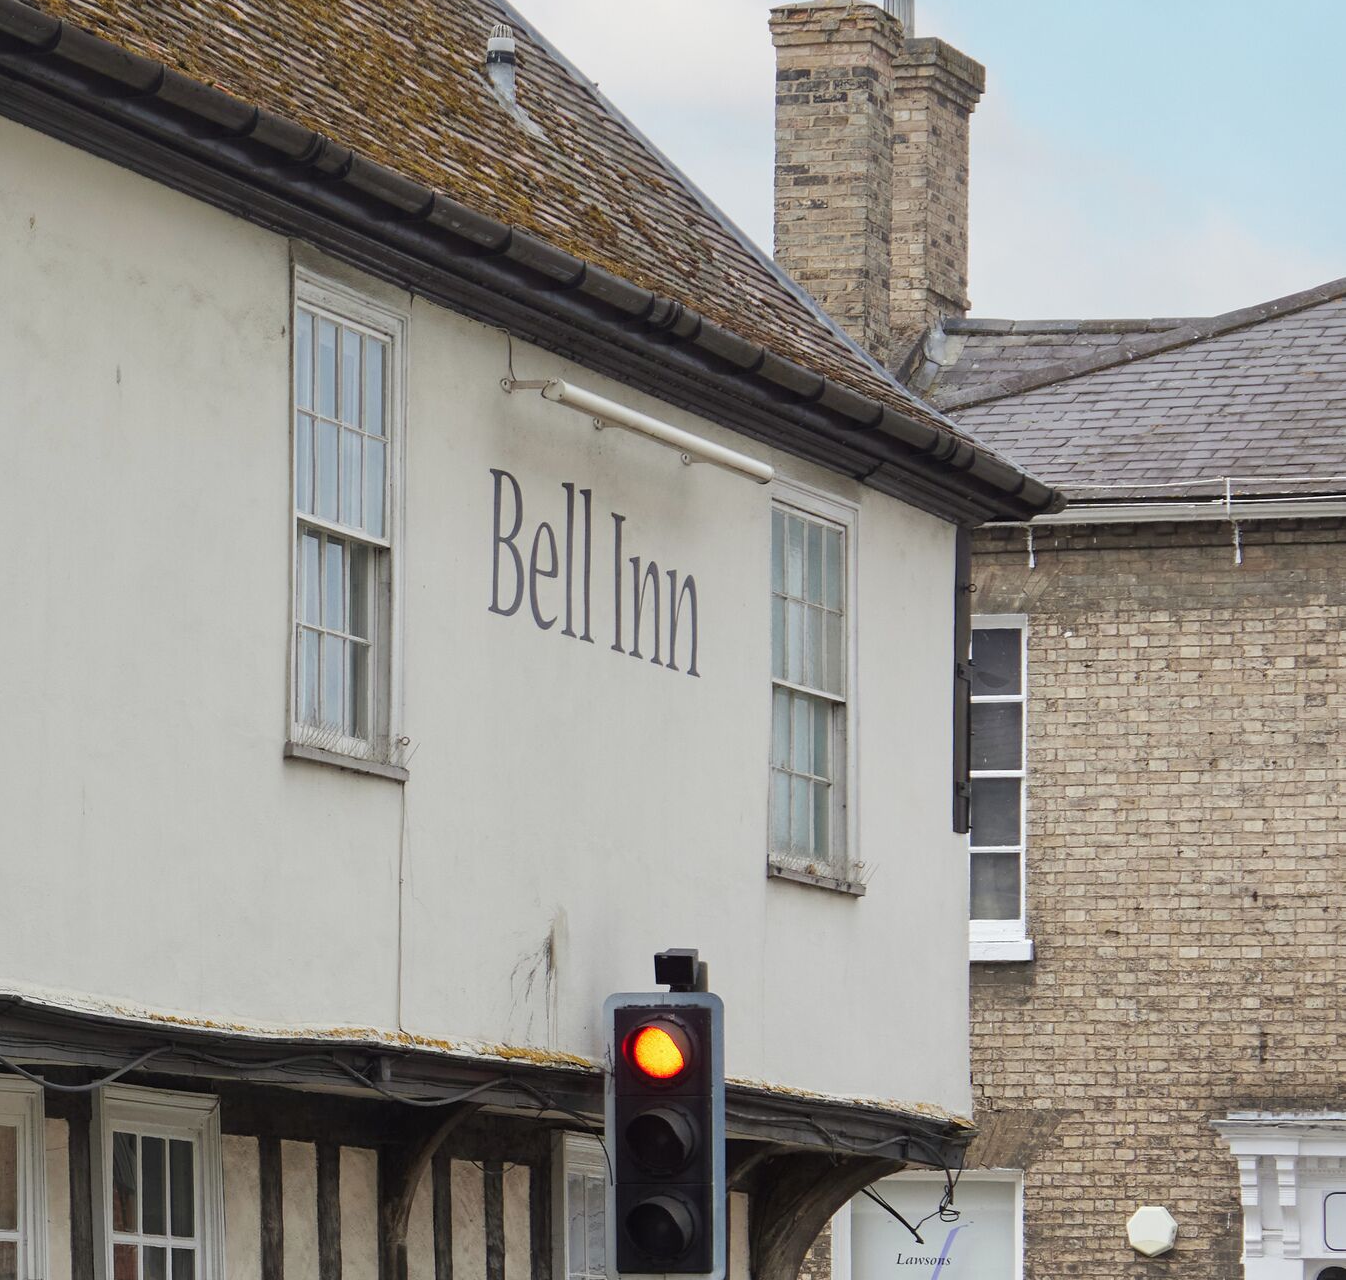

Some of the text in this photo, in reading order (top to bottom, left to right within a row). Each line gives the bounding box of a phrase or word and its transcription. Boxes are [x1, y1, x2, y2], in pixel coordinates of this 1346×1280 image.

[488, 468, 701, 678] Bell Inn
[896, 1253, 952, 1266] Lawsons
